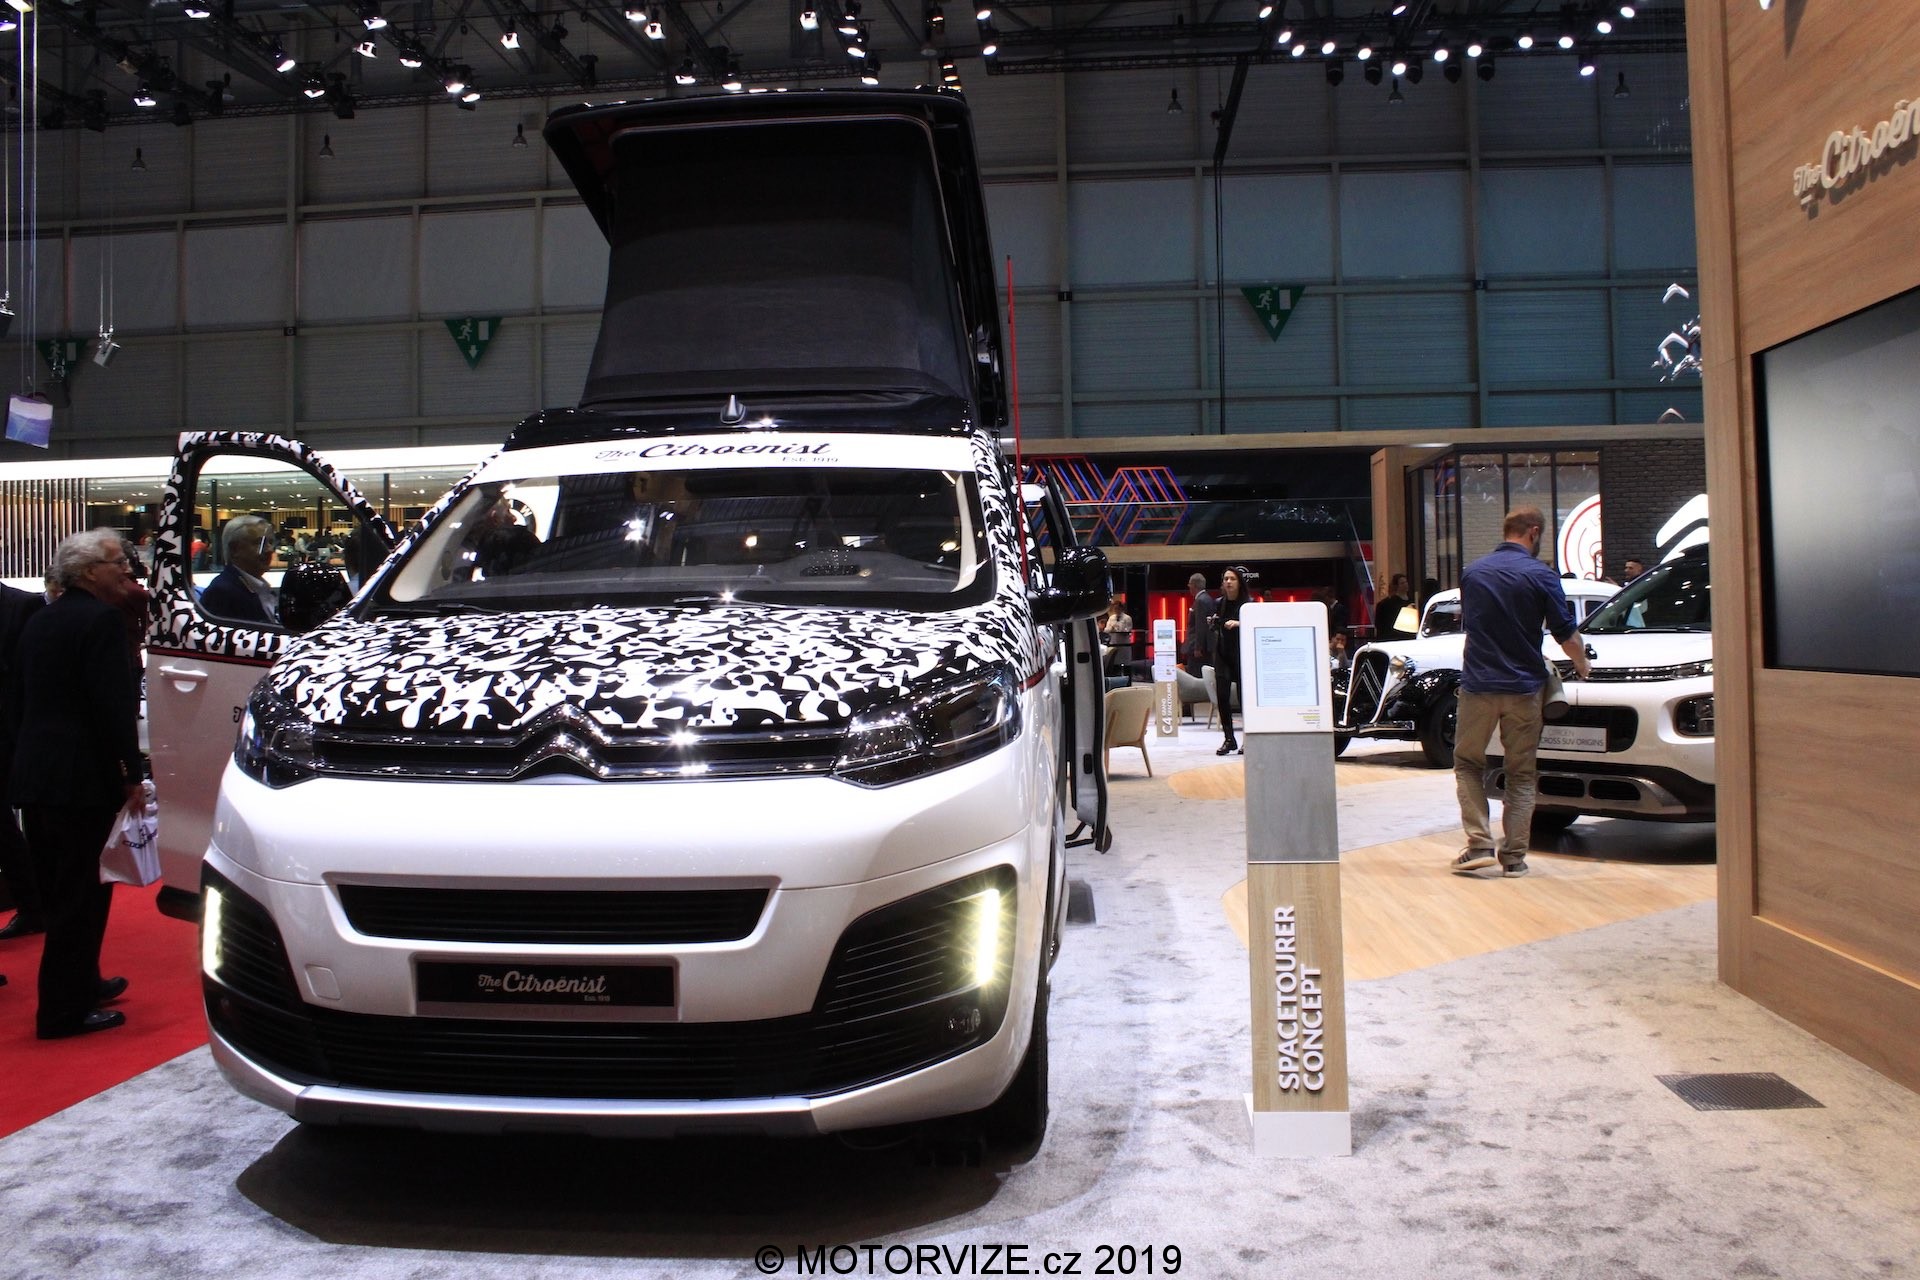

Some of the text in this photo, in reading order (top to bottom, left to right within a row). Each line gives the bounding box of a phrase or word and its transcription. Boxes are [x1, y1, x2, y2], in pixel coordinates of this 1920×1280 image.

[1162, 718, 1173, 734] C4
[478, 974, 502, 992] The
[1274, 905, 1299, 1092] SPACETOURER
[1300, 963, 1325, 1092] CONCEPT
